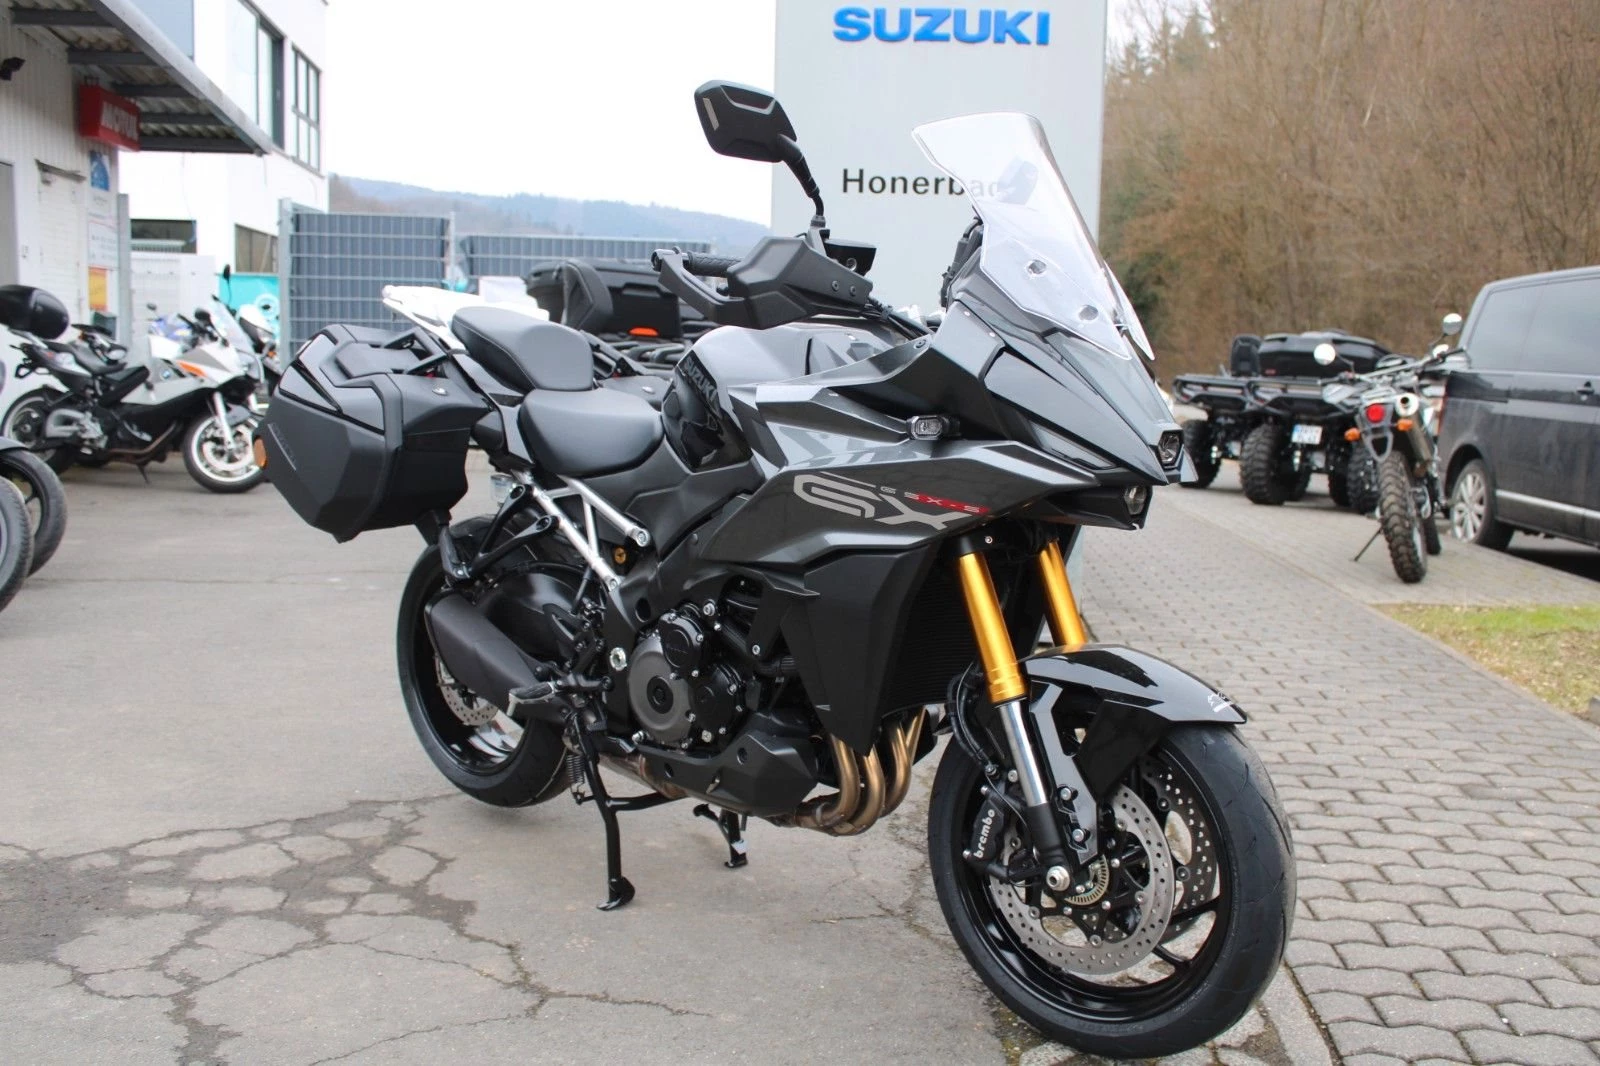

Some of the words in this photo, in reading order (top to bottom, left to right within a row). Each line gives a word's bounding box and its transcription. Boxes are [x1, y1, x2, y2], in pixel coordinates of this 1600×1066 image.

[833, 6, 1051, 46] SUZUKI
[684, 355, 718, 402] SUZUKI
[973, 808, 996, 859] brembo
